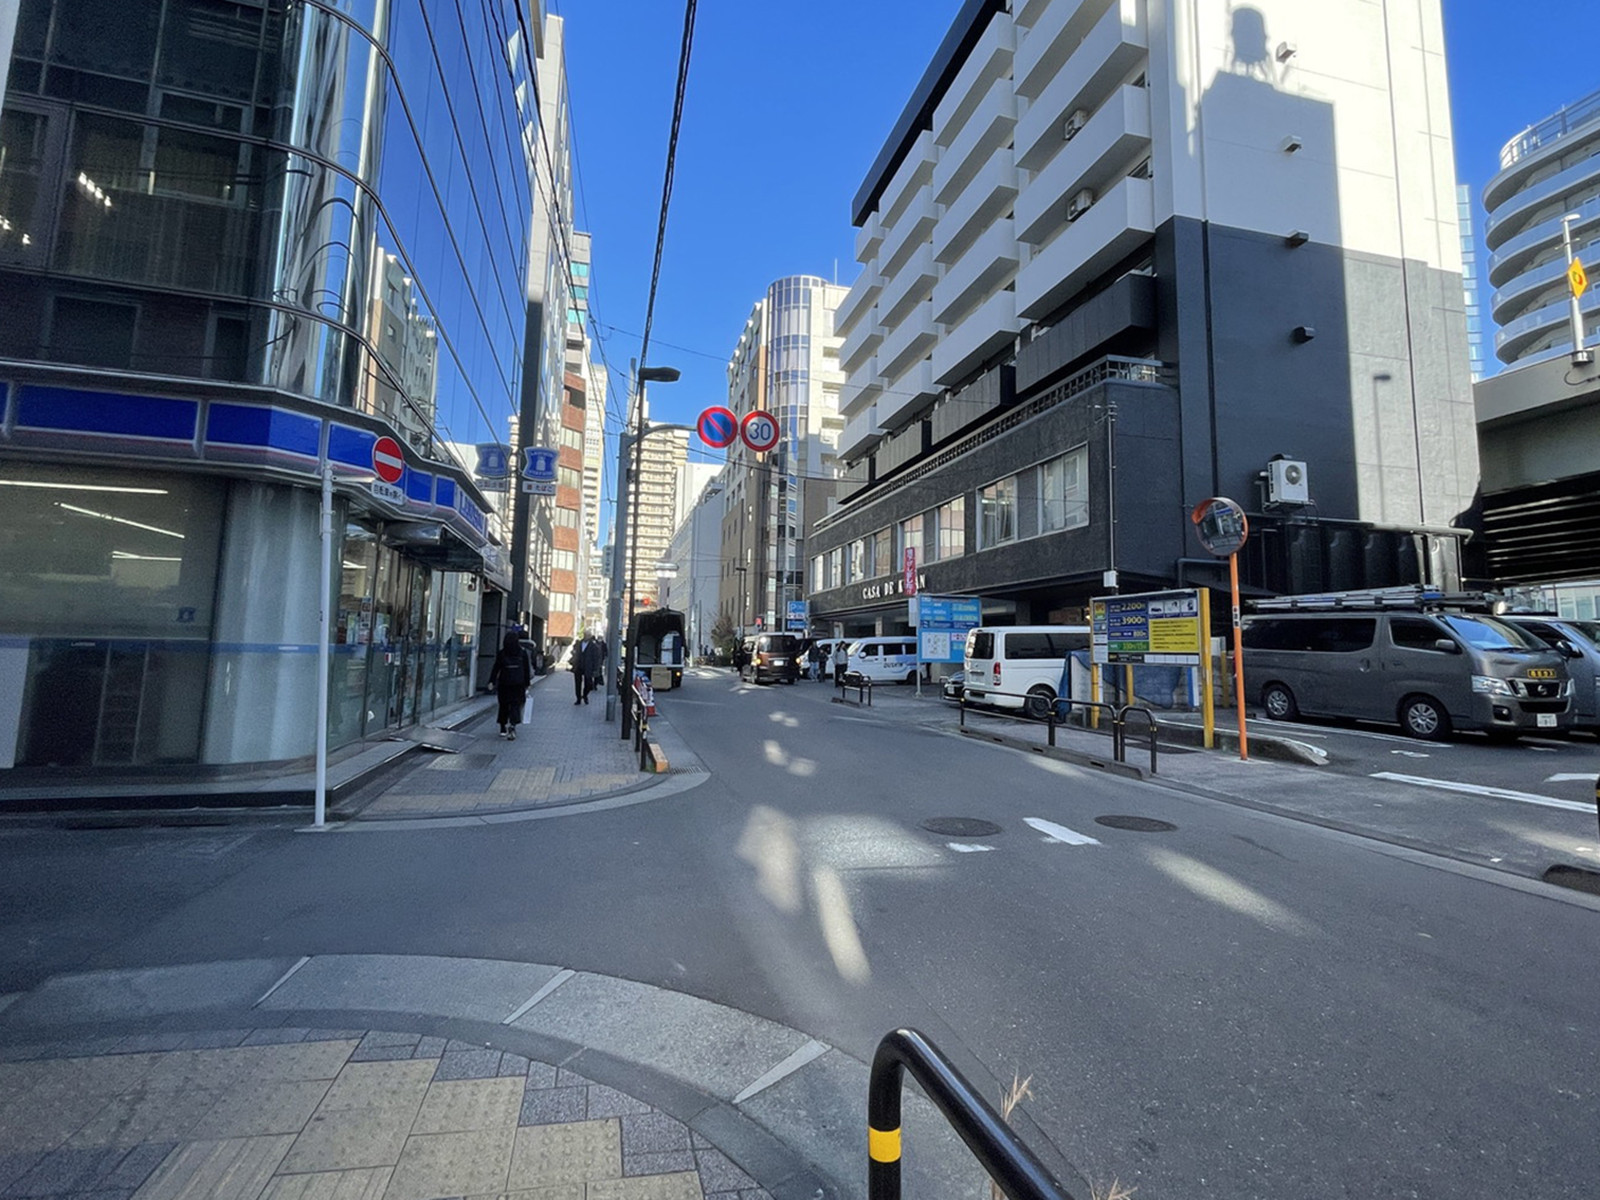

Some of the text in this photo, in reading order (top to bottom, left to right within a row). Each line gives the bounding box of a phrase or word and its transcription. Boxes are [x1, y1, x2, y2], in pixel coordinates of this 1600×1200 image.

[749, 422, 771, 441] 30
[862, 585, 881, 600] CASA
[884, 581, 894, 596] DE
